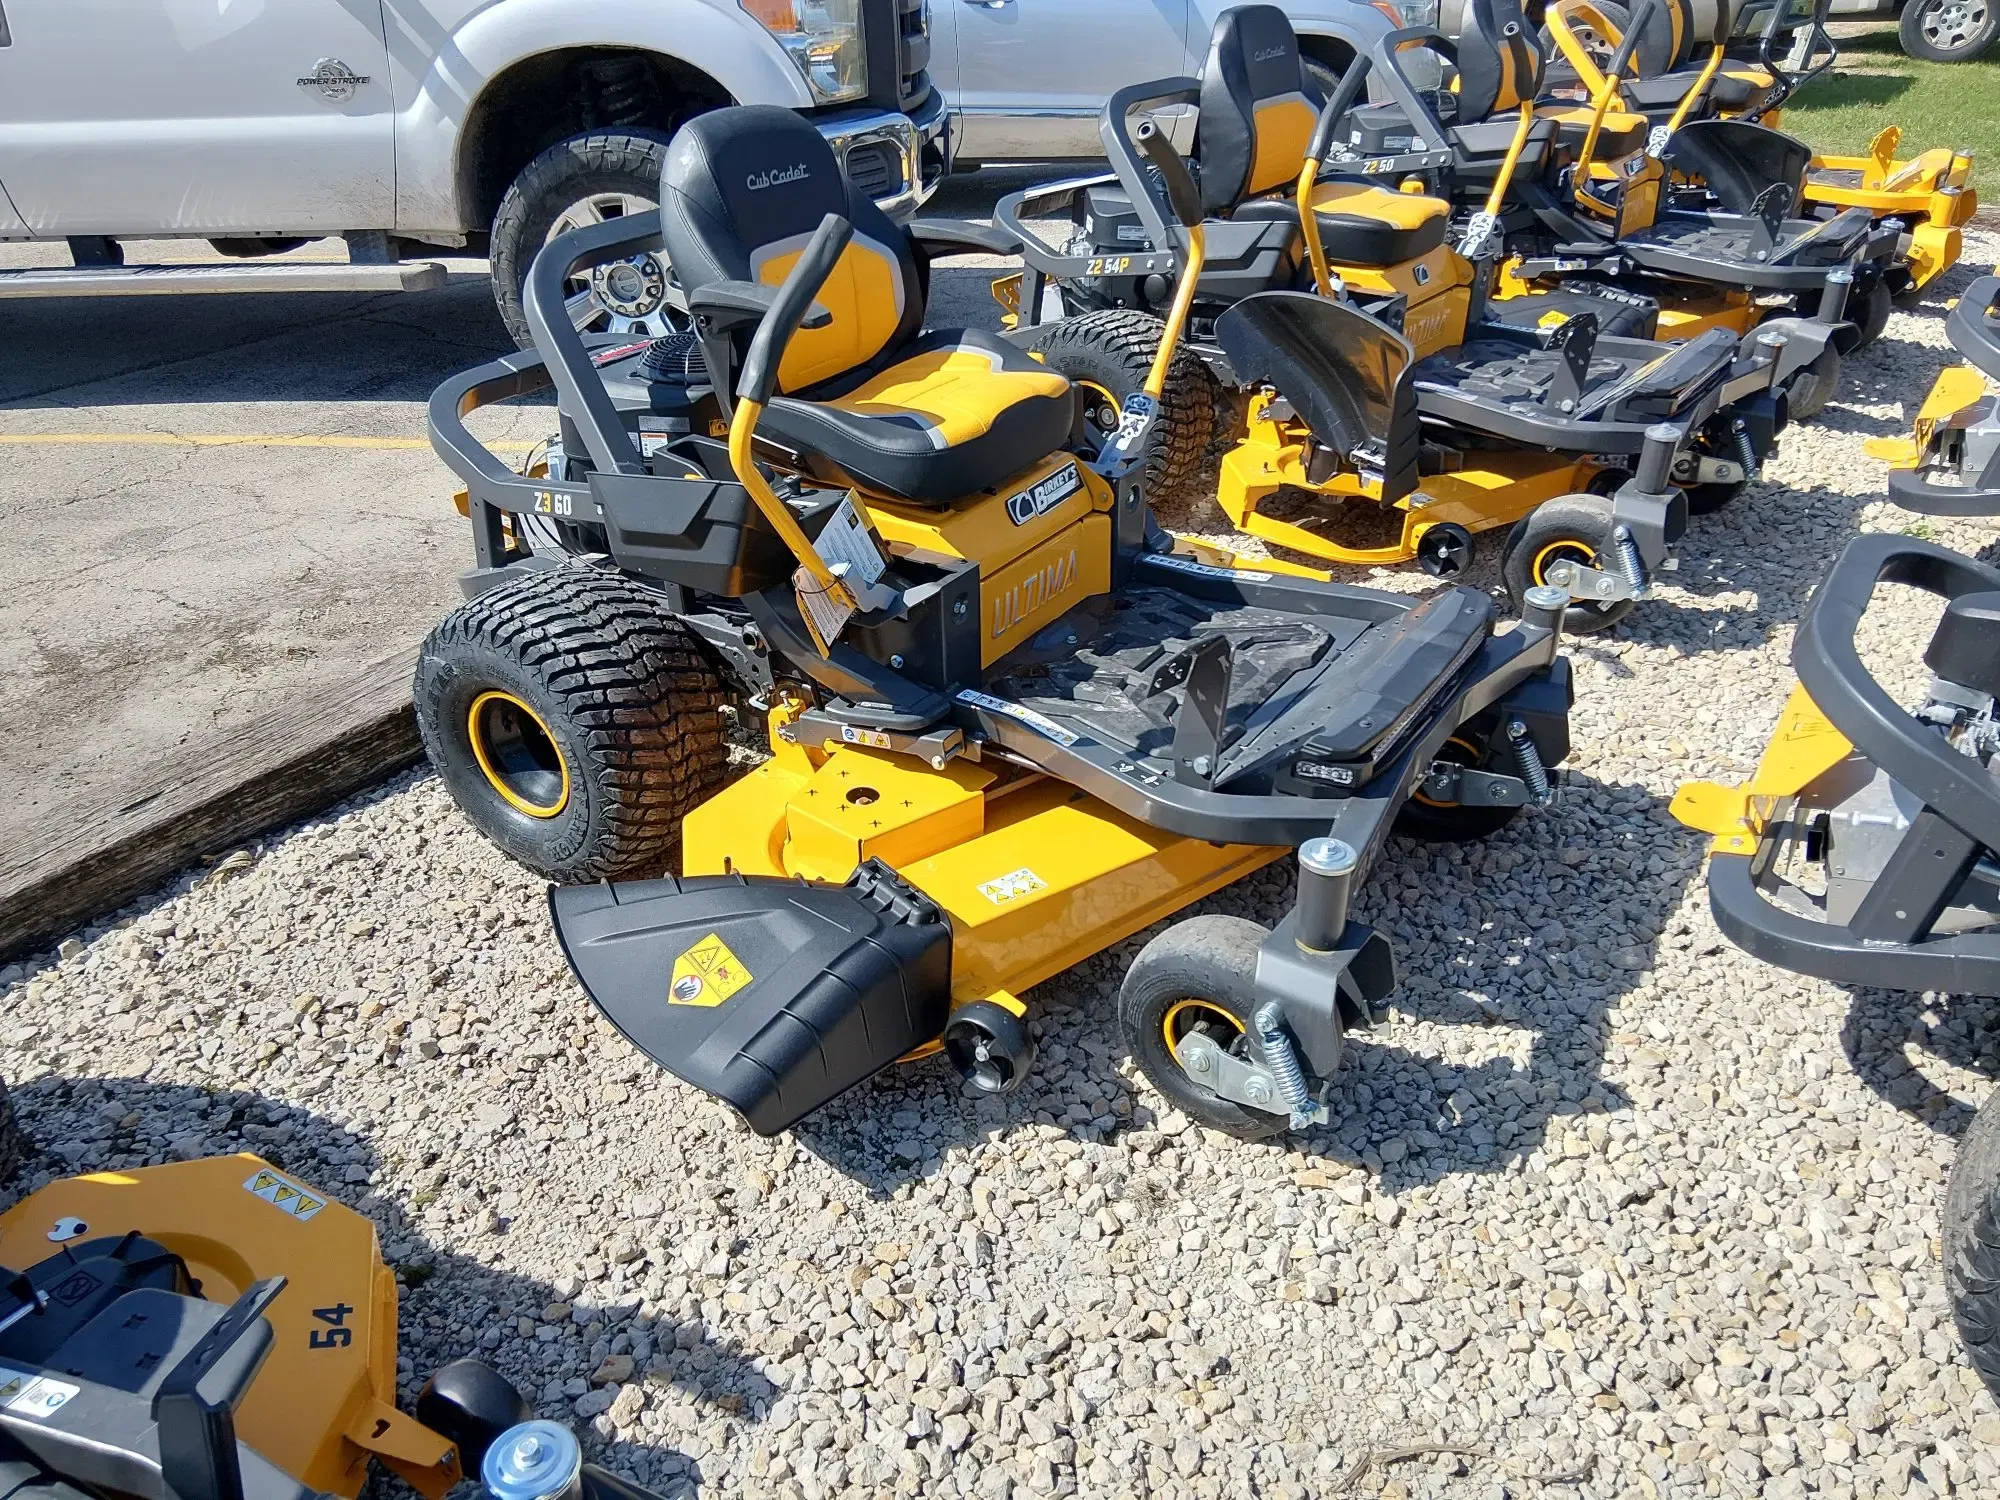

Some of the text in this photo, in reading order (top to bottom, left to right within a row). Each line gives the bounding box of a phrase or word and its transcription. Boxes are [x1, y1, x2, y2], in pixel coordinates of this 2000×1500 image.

[296, 76, 368, 86] POWER STROKE
[747, 163, 809, 190] Cub Cadet
[1361, 159, 1395, 174] Z2 50
[1086, 257, 1130, 275] Z2 54P
[1034, 464, 1078, 513] BIRKEY'S
[534, 491, 572, 516] Z3 60
[992, 549, 1078, 638] ULTIMA
[309, 1302, 353, 1349] 54
